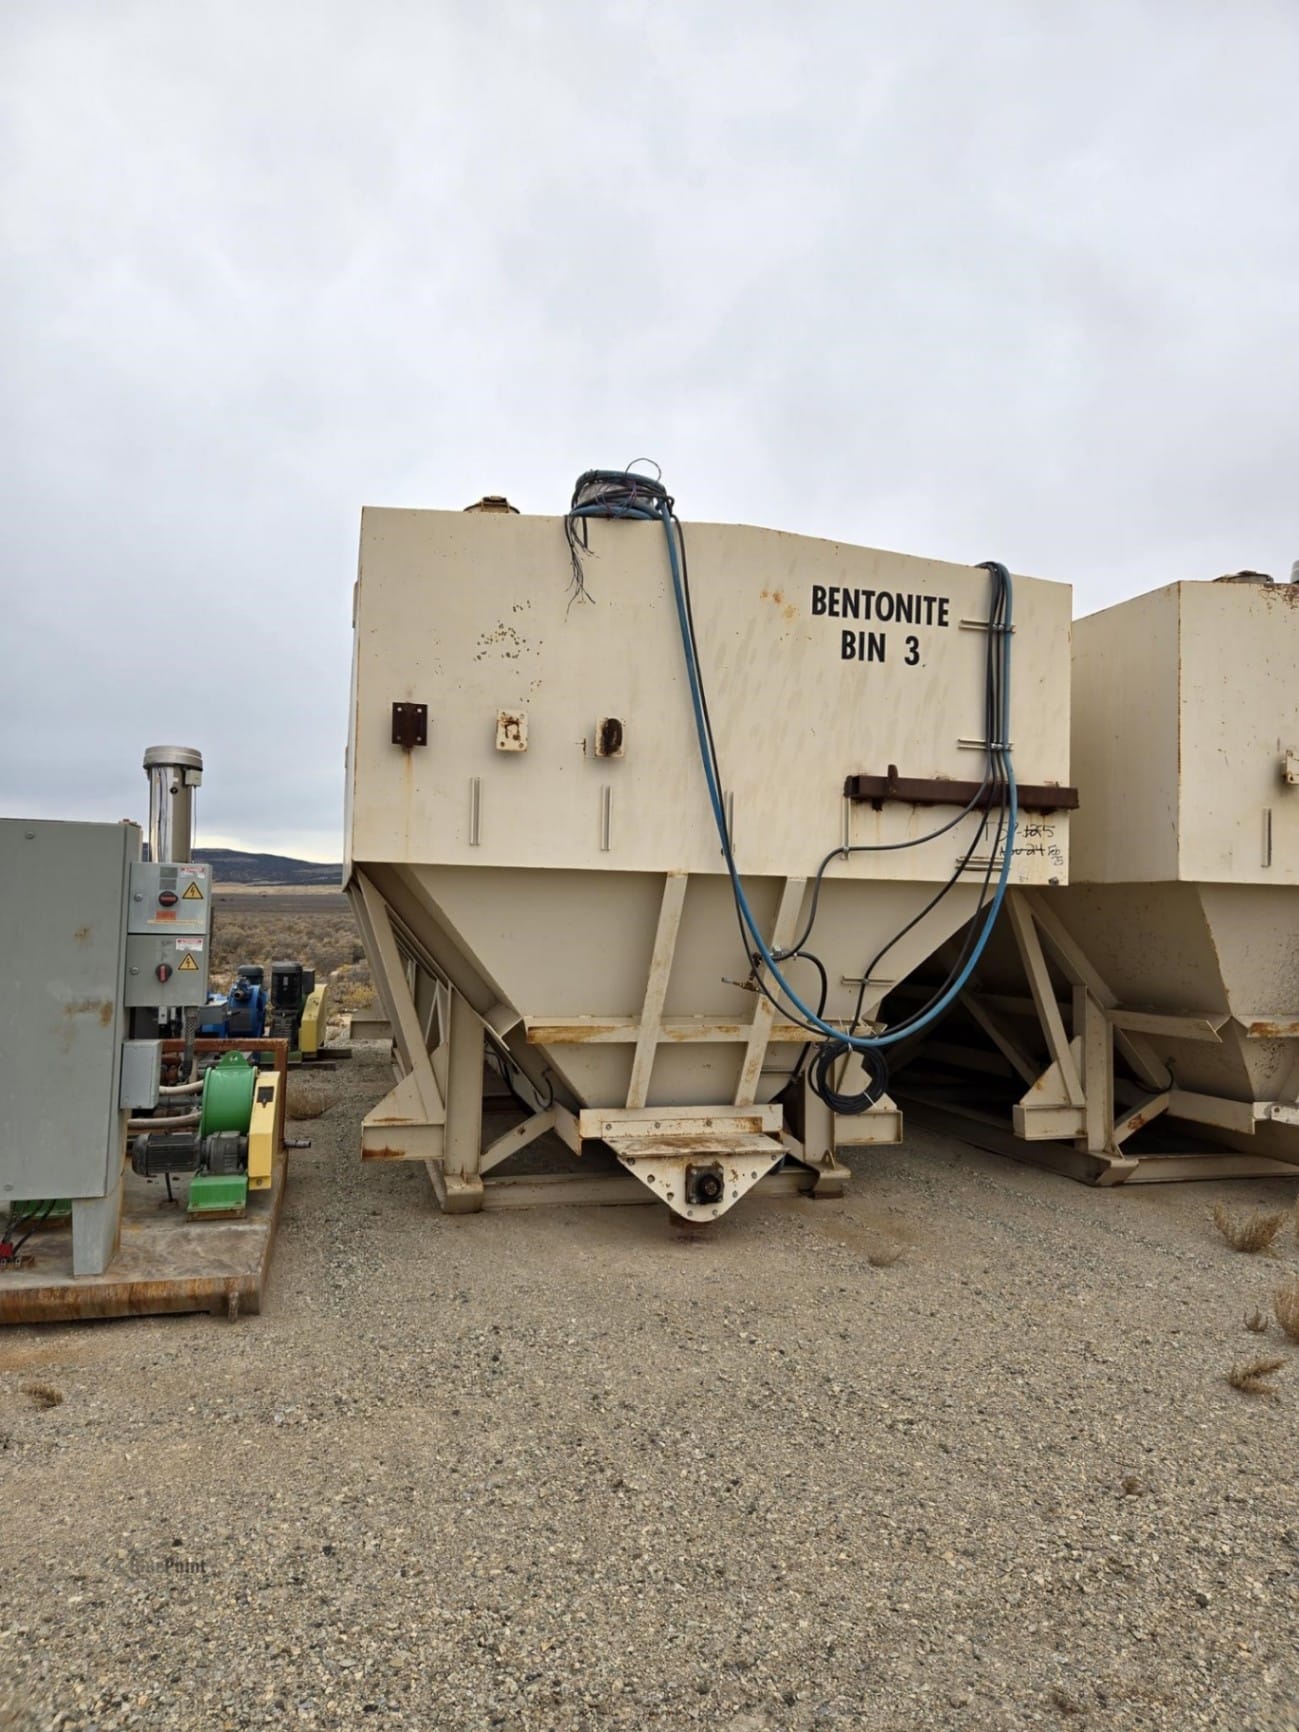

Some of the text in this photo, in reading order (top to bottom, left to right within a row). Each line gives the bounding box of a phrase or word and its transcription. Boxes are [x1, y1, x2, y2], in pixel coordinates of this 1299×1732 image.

[812, 585, 949, 627] BENTONITE
[841, 630, 920, 666] BIN 3
